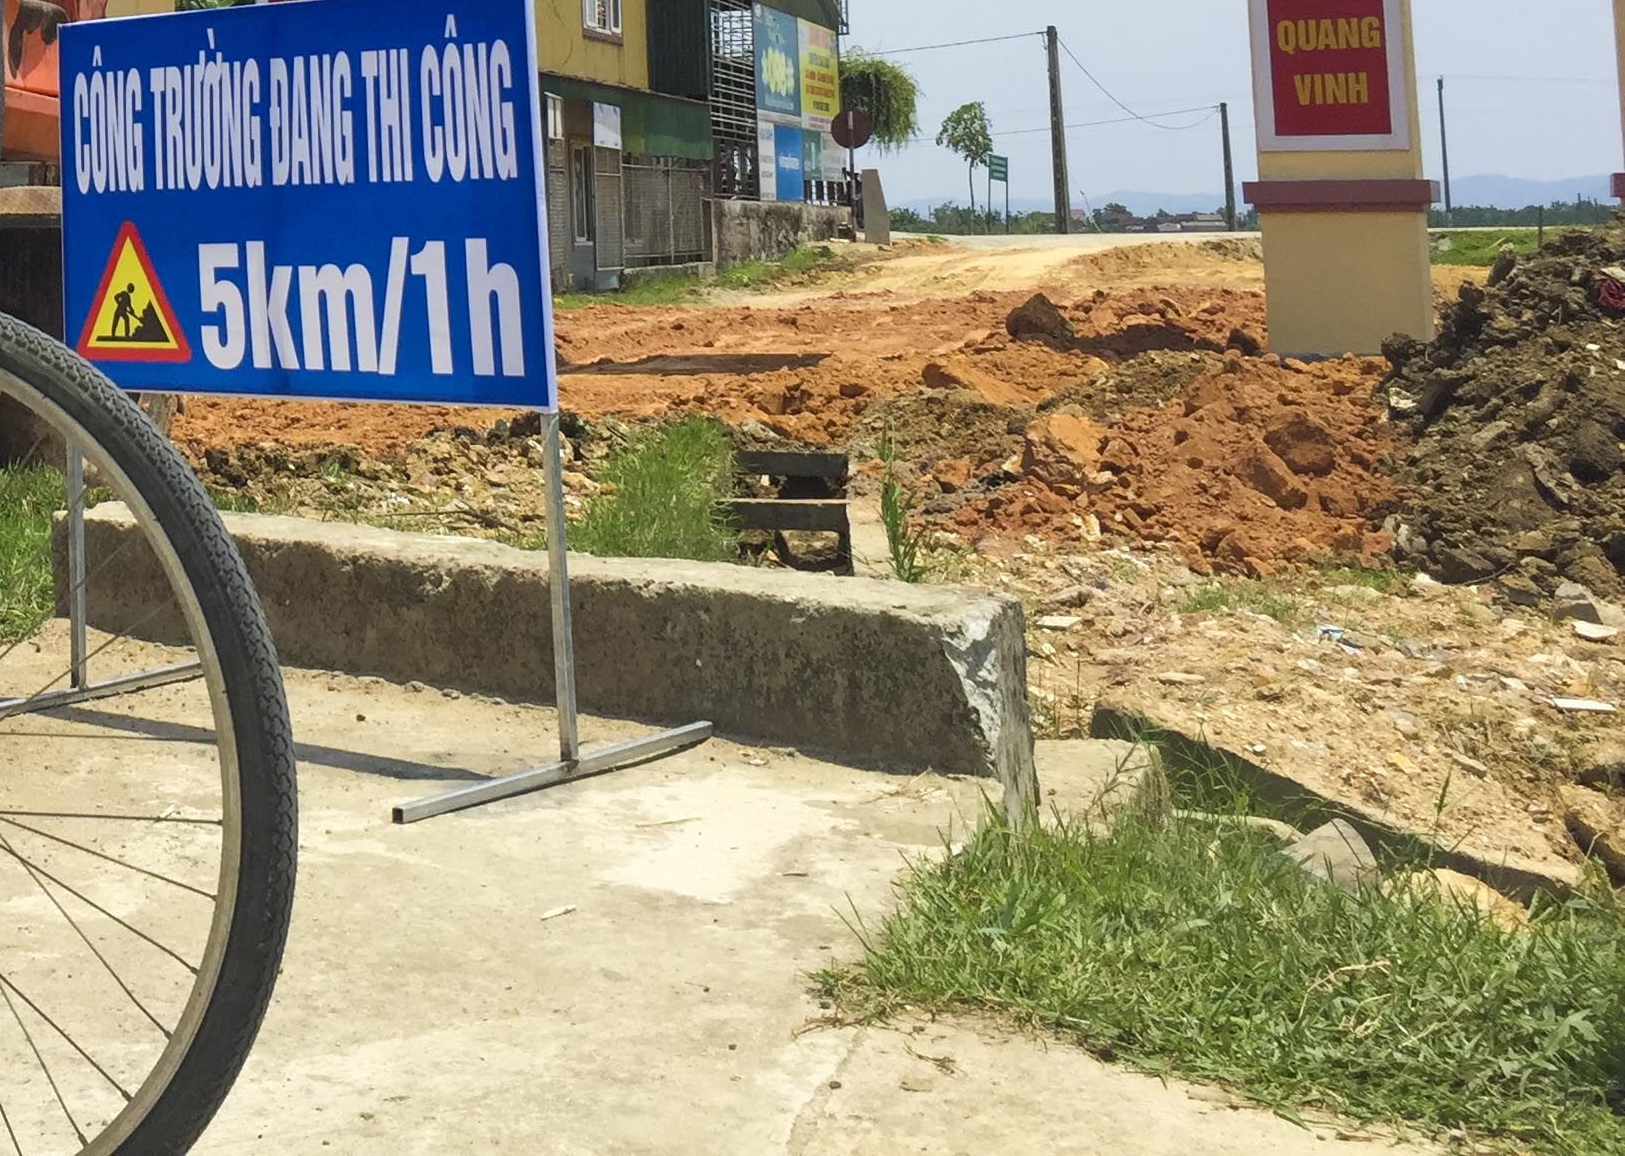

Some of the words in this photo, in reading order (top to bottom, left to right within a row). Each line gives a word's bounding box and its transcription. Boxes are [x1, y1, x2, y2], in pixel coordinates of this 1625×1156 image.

[1276, 17, 1381, 54] QUANG
[73, 45, 143, 195] CÔNG
[150, 28, 262, 190] TRƯỜNG
[269, 50, 354, 186] ĐANG
[361, 48, 412, 182] THI
[420, 14, 517, 183] CÔNG
[1293, 71, 1368, 106] VINH
[198, 236, 524, 377] 5km/1h
